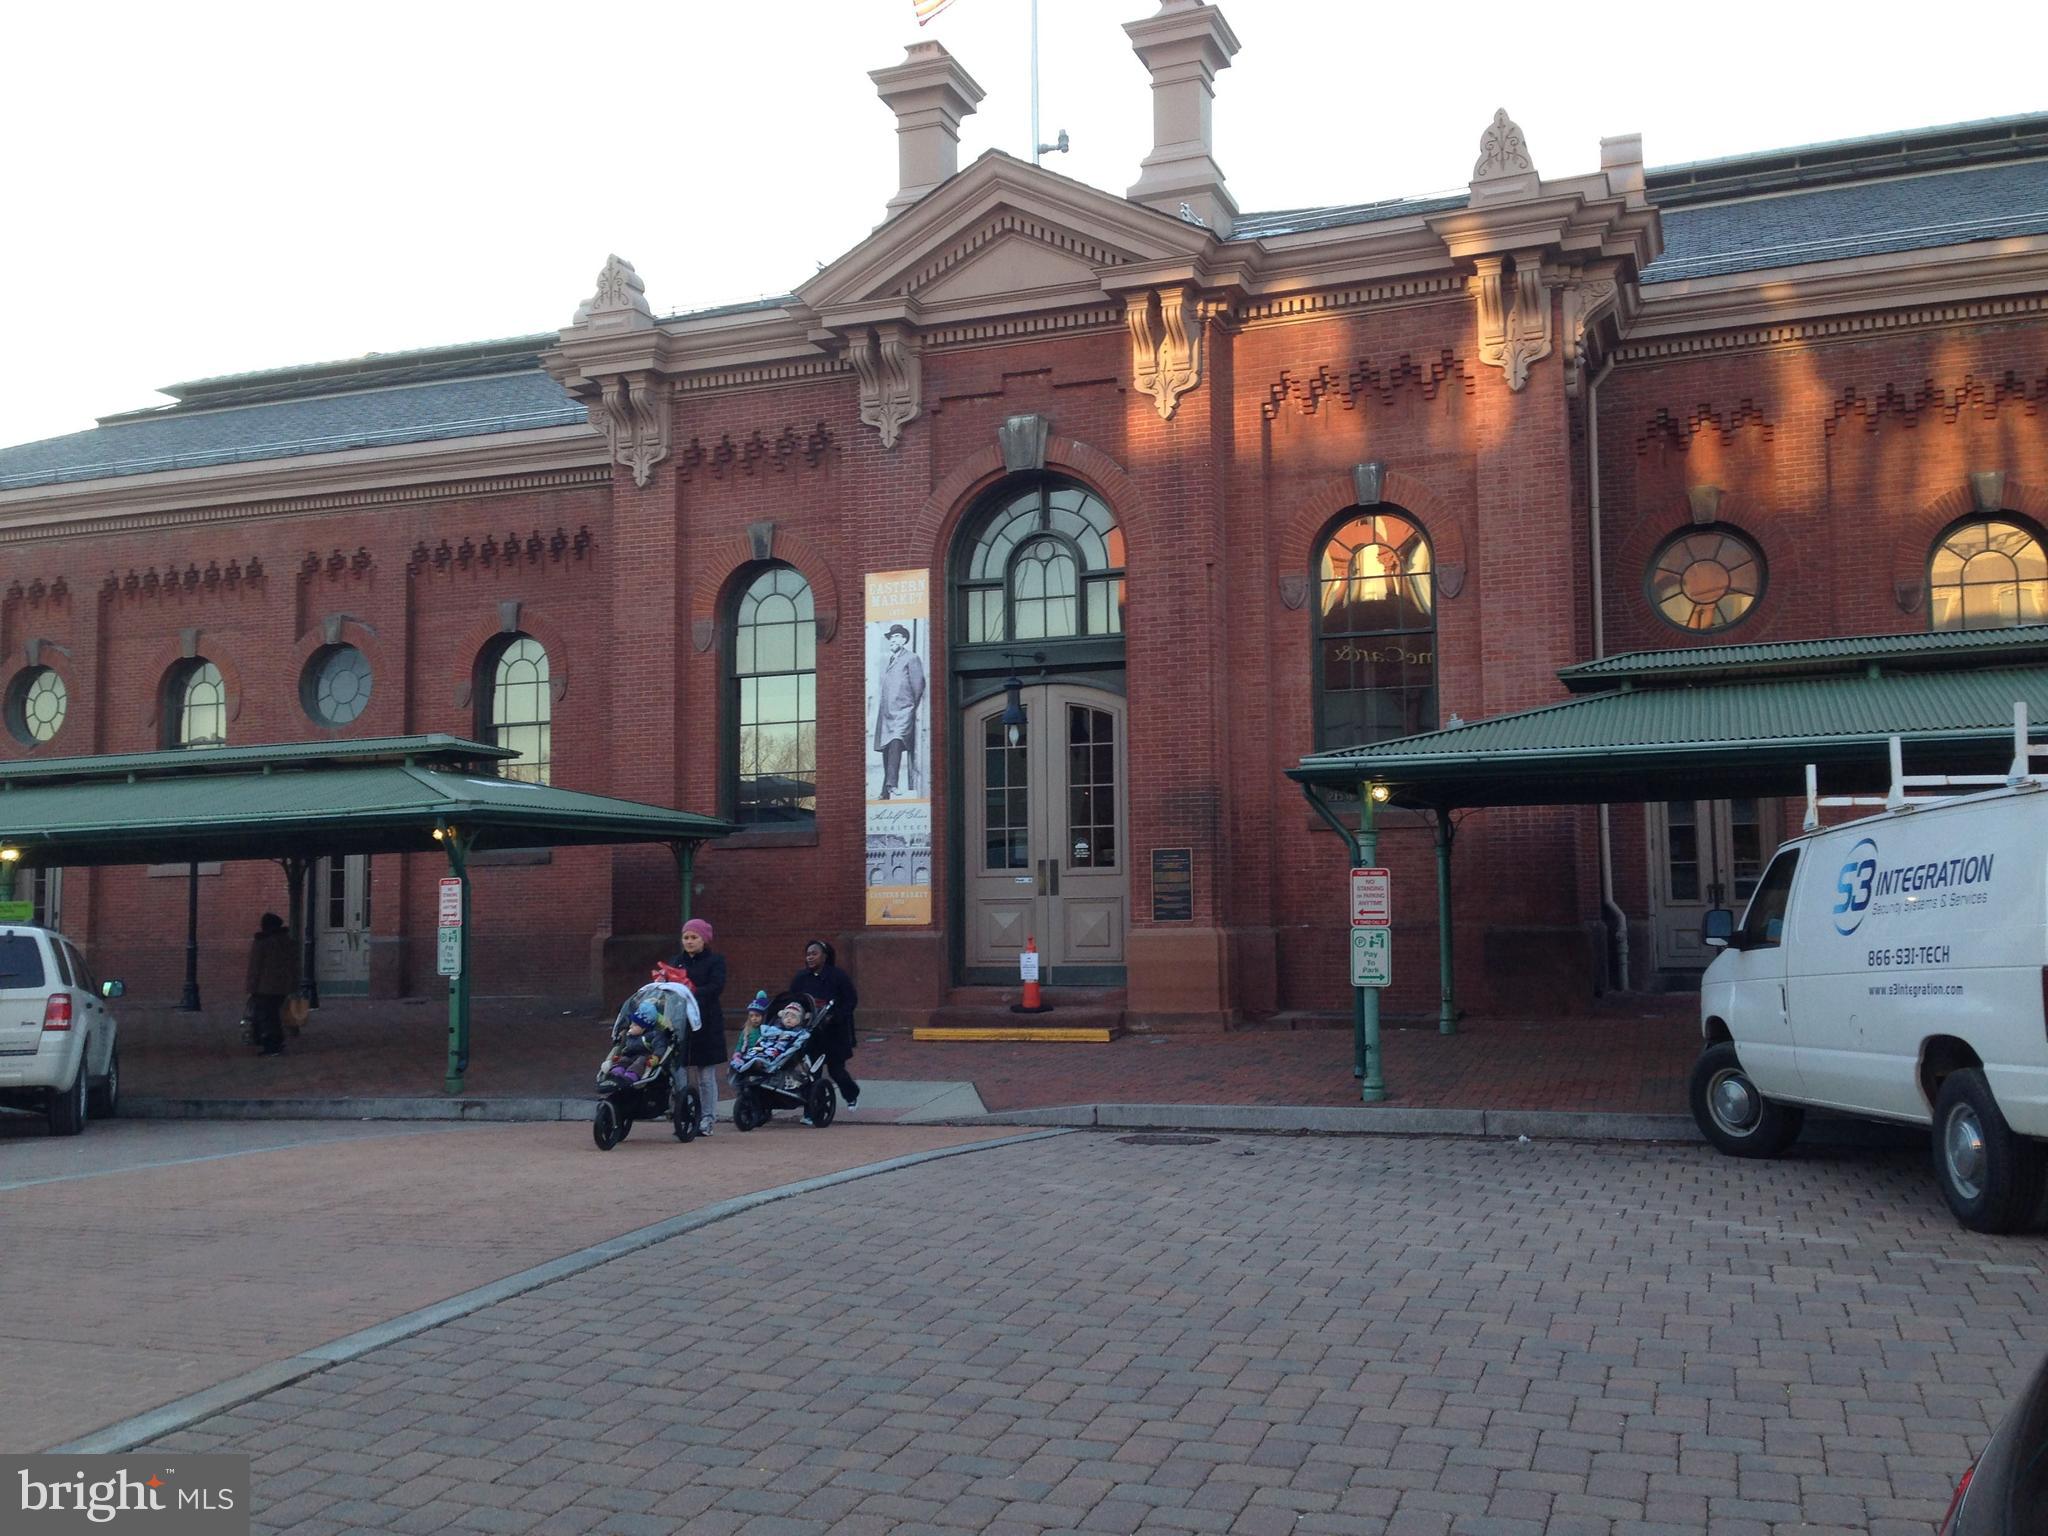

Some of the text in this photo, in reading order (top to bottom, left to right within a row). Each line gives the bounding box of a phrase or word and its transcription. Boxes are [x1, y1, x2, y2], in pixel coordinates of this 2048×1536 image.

[869, 579, 926, 593] EASTERN
[872, 592, 924, 608] MARKET
[1832, 853, 1994, 914] S3 INTEGRATION
[1940, 894, 1947, 908] &
[1949, 892, 1988, 907] Services
[1867, 945, 1950, 967] 866-S3I-TECH
[1868, 983, 1964, 998] www.s3integration.com
